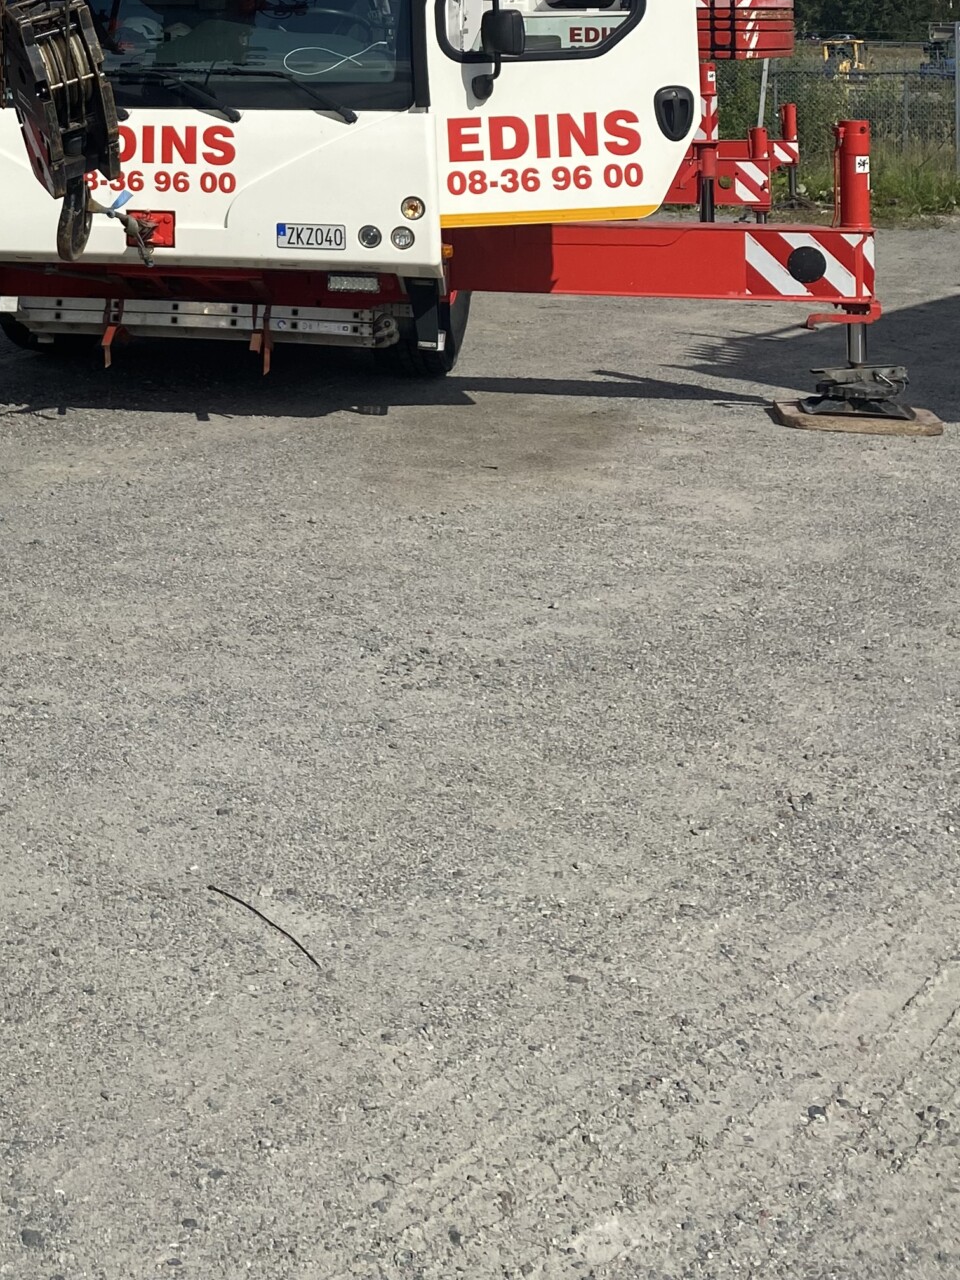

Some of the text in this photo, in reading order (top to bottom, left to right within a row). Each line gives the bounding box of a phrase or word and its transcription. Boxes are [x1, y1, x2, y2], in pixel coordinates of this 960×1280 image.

[118, 125, 236, 166] DINS
[447, 109, 642, 162] EDINS
[83, 169, 237, 194] 8-36 96 00
[447, 162, 644, 196] 08-36 96 00
[287, 226, 343, 247] ZKZ040
